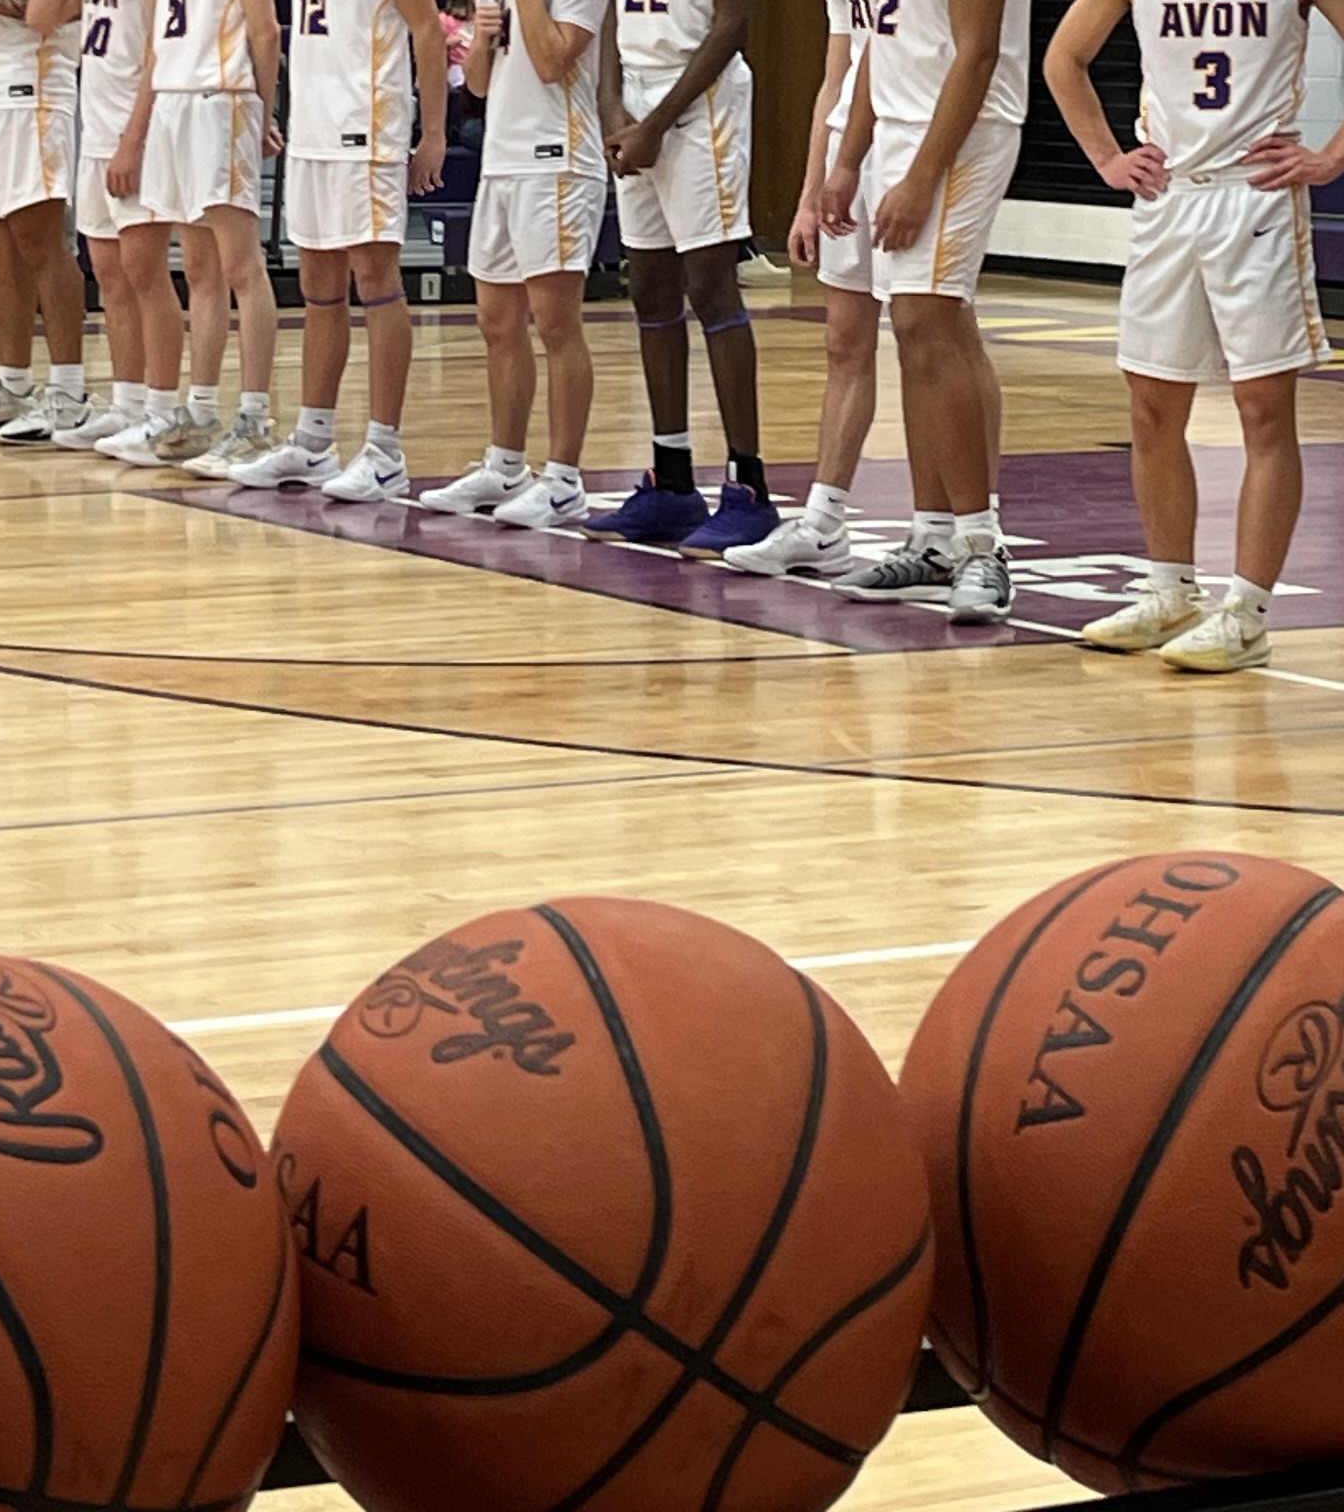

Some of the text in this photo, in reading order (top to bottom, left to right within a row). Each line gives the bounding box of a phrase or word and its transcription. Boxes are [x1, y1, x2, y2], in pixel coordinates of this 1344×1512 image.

[1160, 1, 1267, 38] AVON
[1192, 51, 1231, 111] 3
[1014, 857, 1243, 1136] OHSAA
